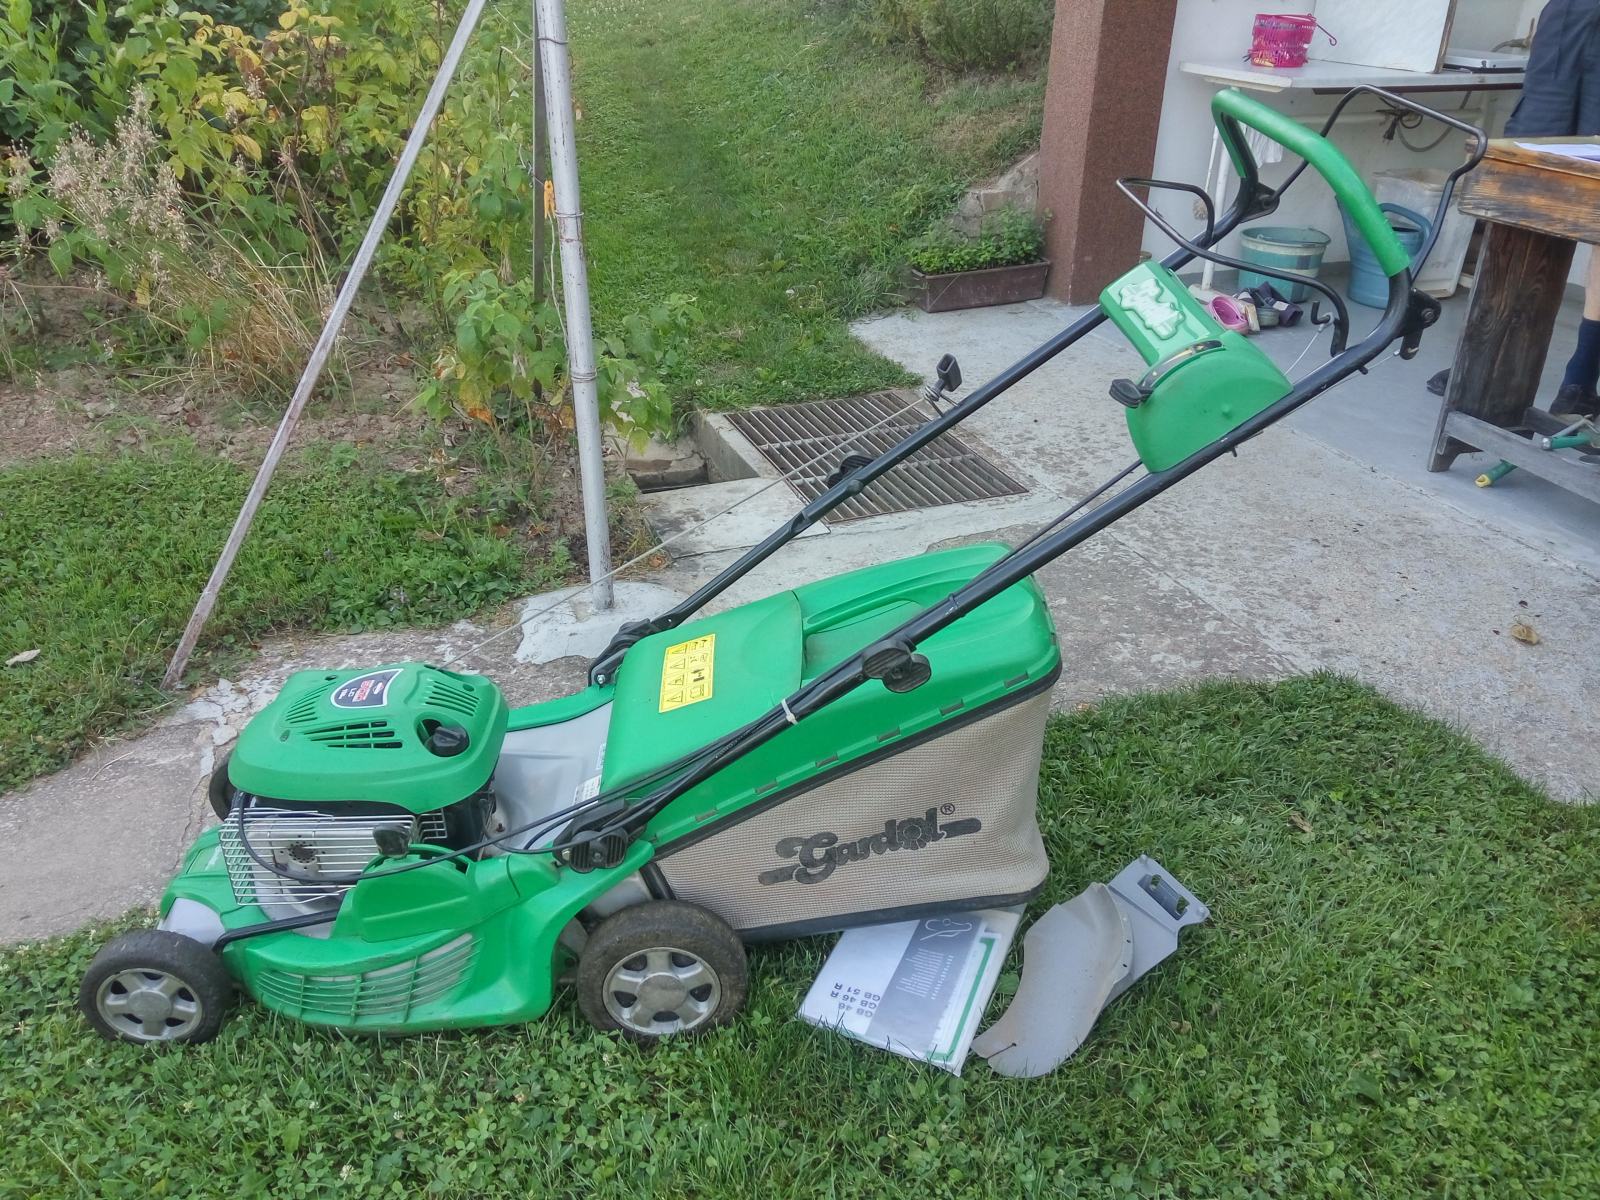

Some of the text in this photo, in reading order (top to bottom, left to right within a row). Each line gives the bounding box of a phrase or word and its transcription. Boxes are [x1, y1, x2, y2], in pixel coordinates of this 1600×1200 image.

[847, 987, 860, 995] 51
[831, 990, 876, 1009] GB 46 R
[864, 992, 880, 1001] GB
[856, 1008, 873, 1017] GB
